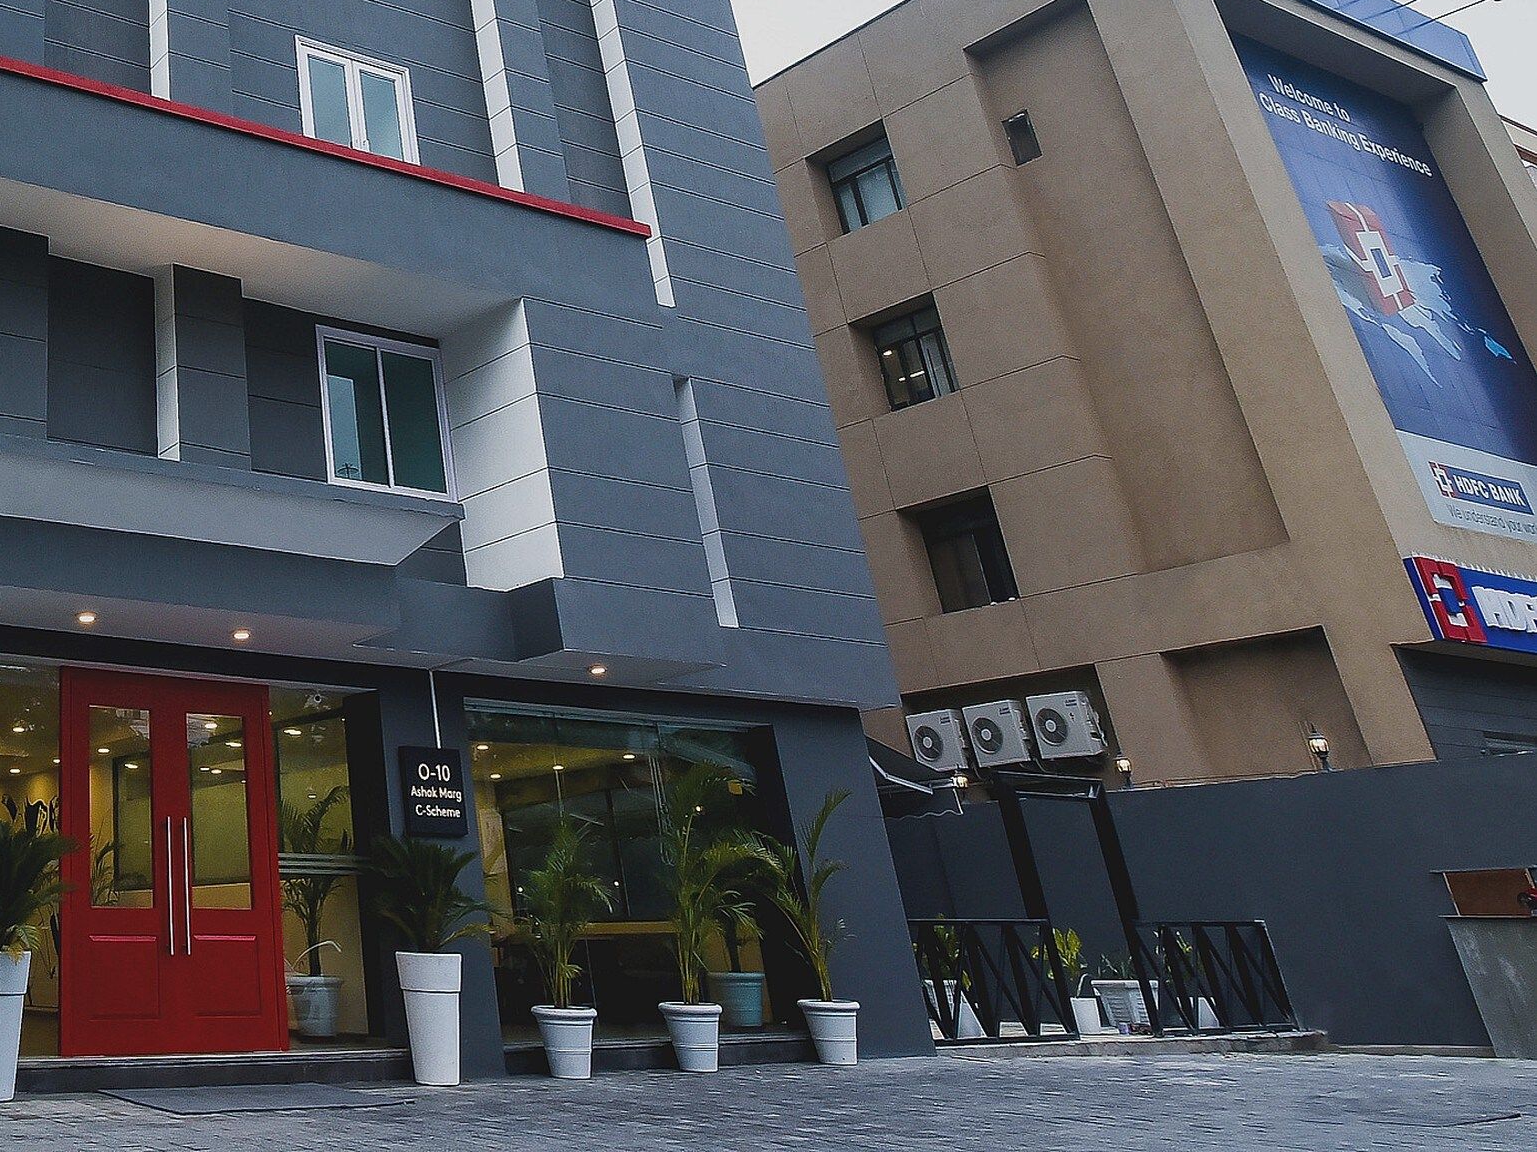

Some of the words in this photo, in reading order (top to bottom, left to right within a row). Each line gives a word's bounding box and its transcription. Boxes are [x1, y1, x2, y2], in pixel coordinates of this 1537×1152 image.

[1267, 73, 1333, 116] Welcome
[1333, 103, 1351, 123] to
[1258, 92, 1301, 124] Class
[1302, 110, 1360, 151] Banking
[1360, 134, 1434, 178] Experience
[1452, 474, 1489, 499] HDFC
[1487, 483, 1526, 507] BANK
[418, 763, 451, 782] O-10
[411, 785, 438, 799] Ashok
[438, 787, 462, 803] Marg
[415, 804, 461, 818] C-Scheme
